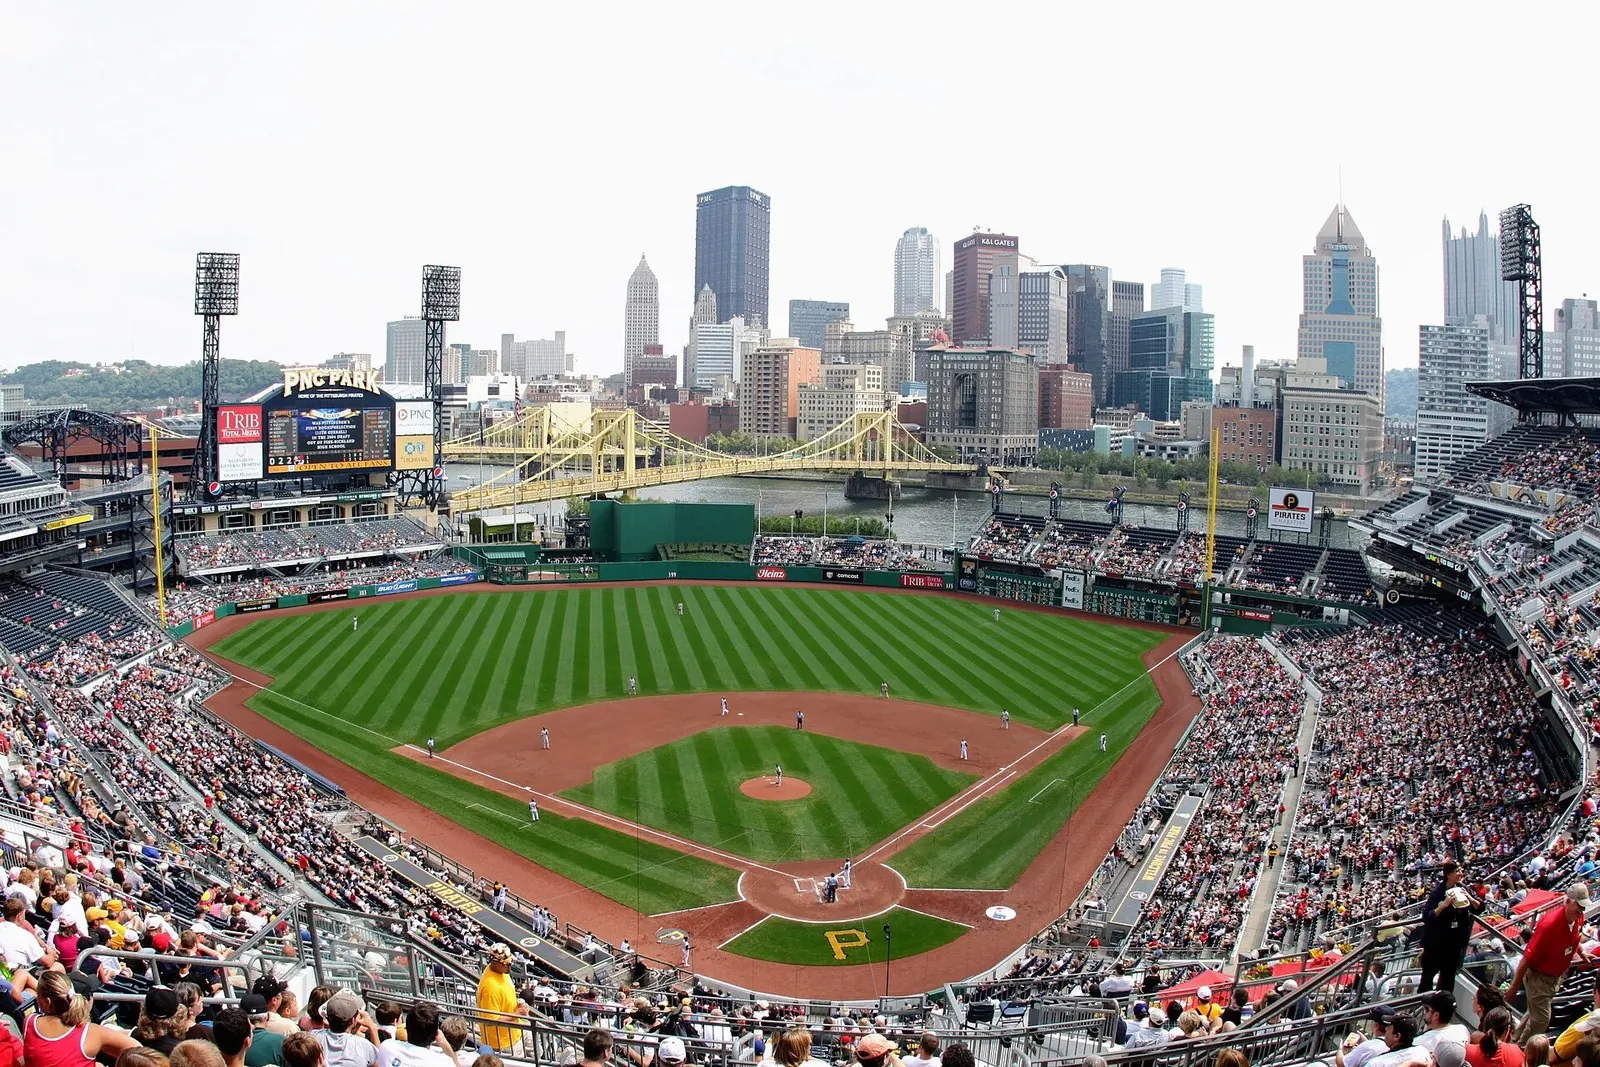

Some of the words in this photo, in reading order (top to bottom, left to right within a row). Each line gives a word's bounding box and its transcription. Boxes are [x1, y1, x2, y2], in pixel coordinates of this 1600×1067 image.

[750, 190, 762, 202] UPMC
[284, 369, 326, 398] PNC
[329, 368, 381, 395] PARK
[221, 411, 260, 429] TRIB
[410, 410, 431, 419] PNC
[222, 429, 240, 437] TOTAL
[299, 462, 327, 470] OPEN
[1288, 497, 1294, 507] P
[1274, 511, 1305, 520] PIRATES
[664, 543, 751, 560] PIRATES
[757, 568, 785, 577] Heinz
[901, 575, 924, 586] TRIB
[985, 575, 1020, 583] NATIONAL
[1093, 591, 1134, 600] AMERICAN
[1137, 596, 1167, 605] LEAGUE
[426, 882, 483, 914] PIRATES
[824, 929, 870, 960] P
